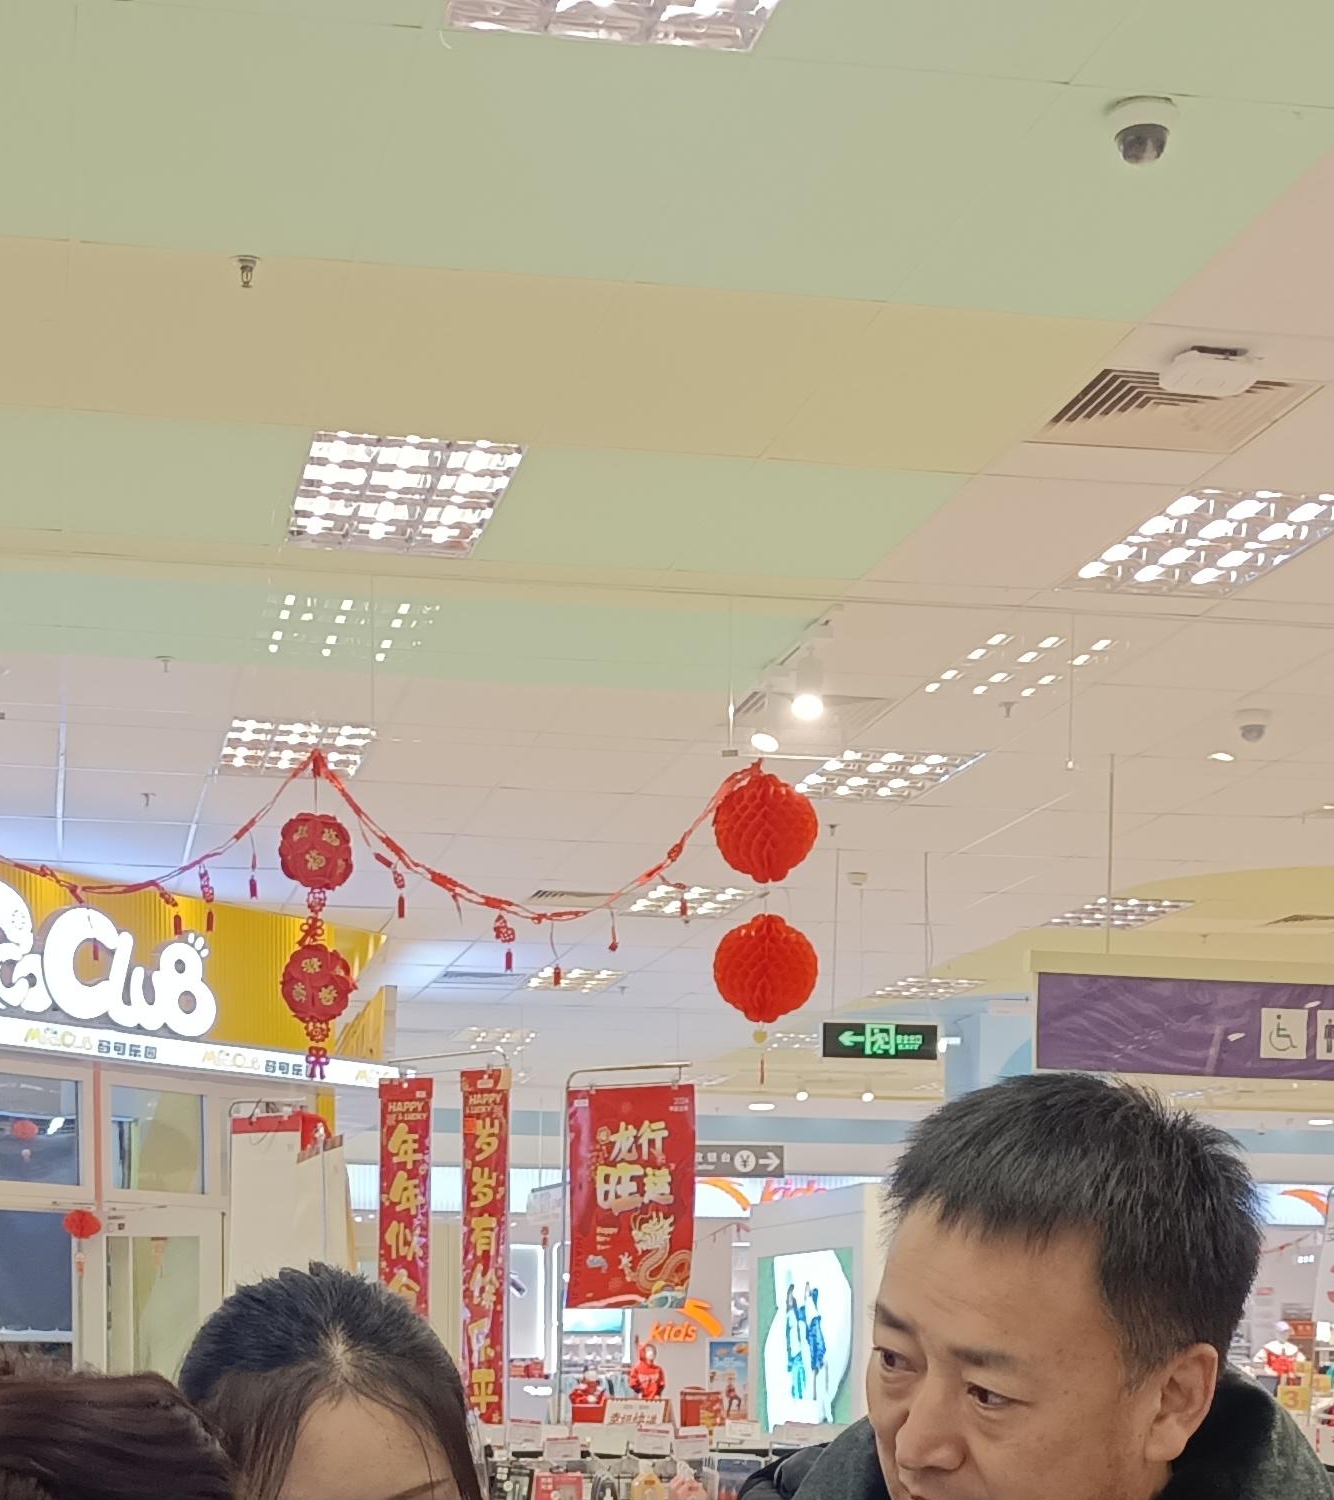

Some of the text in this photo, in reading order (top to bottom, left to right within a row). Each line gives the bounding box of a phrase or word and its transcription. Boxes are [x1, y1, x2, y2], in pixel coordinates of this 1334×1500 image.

[387, 1101, 424, 1113] HAPPY
[609, 1120, 669, 1161] 龙行
[650, 1320, 698, 1344] kids
